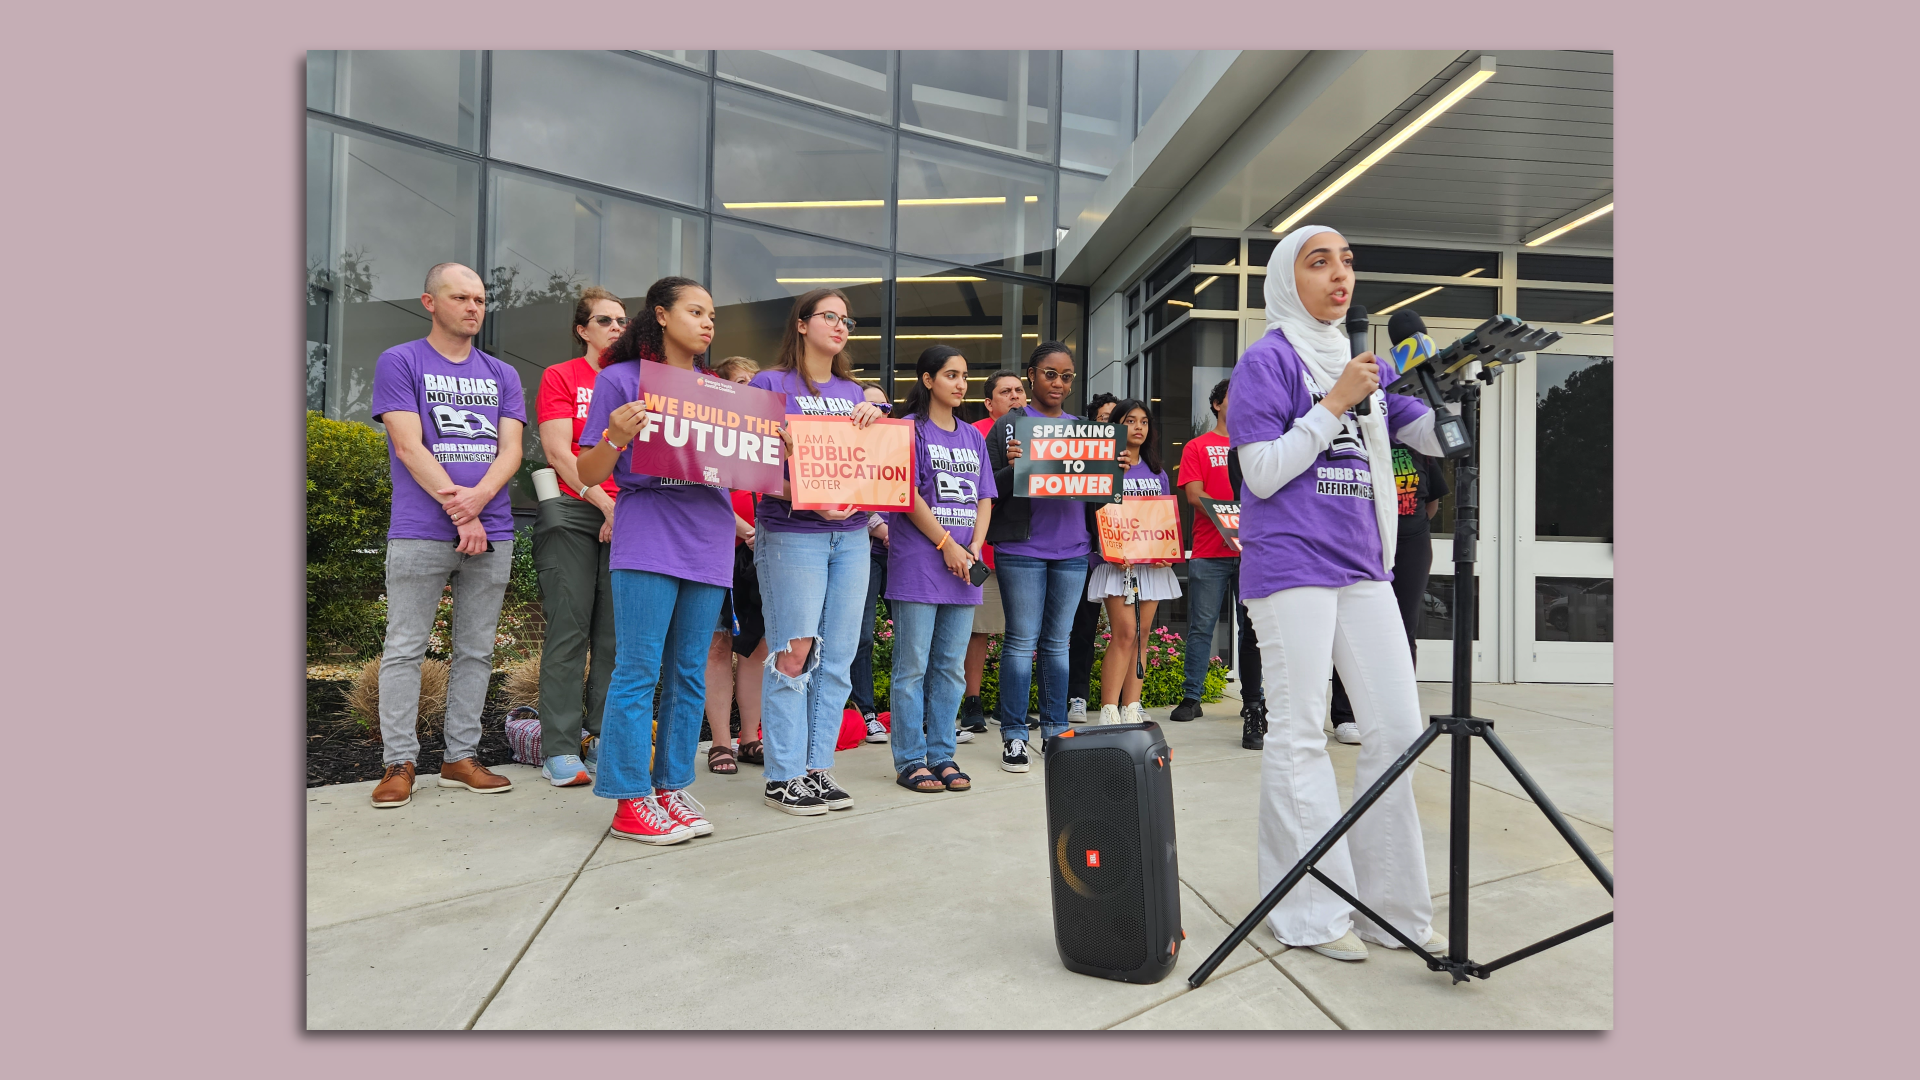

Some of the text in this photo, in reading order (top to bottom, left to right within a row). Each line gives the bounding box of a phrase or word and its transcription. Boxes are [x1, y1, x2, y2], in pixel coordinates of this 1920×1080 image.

[1397, 337, 1426, 374] 2
[423, 374, 498, 395] BAN BIAS
[426, 391, 499, 407] NOT BOOKS
[643, 392, 781, 438] WE BUILD THE
[638, 410, 781, 466] FUTURE
[1032, 424, 1115, 438] SPEAKING
[796, 434, 836, 444] I AM A
[432, 443, 457, 453] COBB
[457, 443, 490, 453] STANDS
[798, 445, 867, 462] PUBLIC
[1032, 440, 1114, 459] YOUTH
[433, 453, 474, 463] AFFIRMING
[931, 458, 951, 471] NOT
[799, 463, 907, 482] EDUCATION
[1062, 460, 1086, 473] TO
[1317, 467, 1354, 481] COBB
[801, 479, 841, 490] VOTER
[1030, 475, 1112, 494] POWER
[1122, 478, 1162, 490] AN BIAS
[931, 506, 952, 516] COBB
[1100, 516, 1140, 530] PUBLIC
[1102, 528, 1176, 541] EDUCATION
[1104, 540, 1123, 549] VOTER
